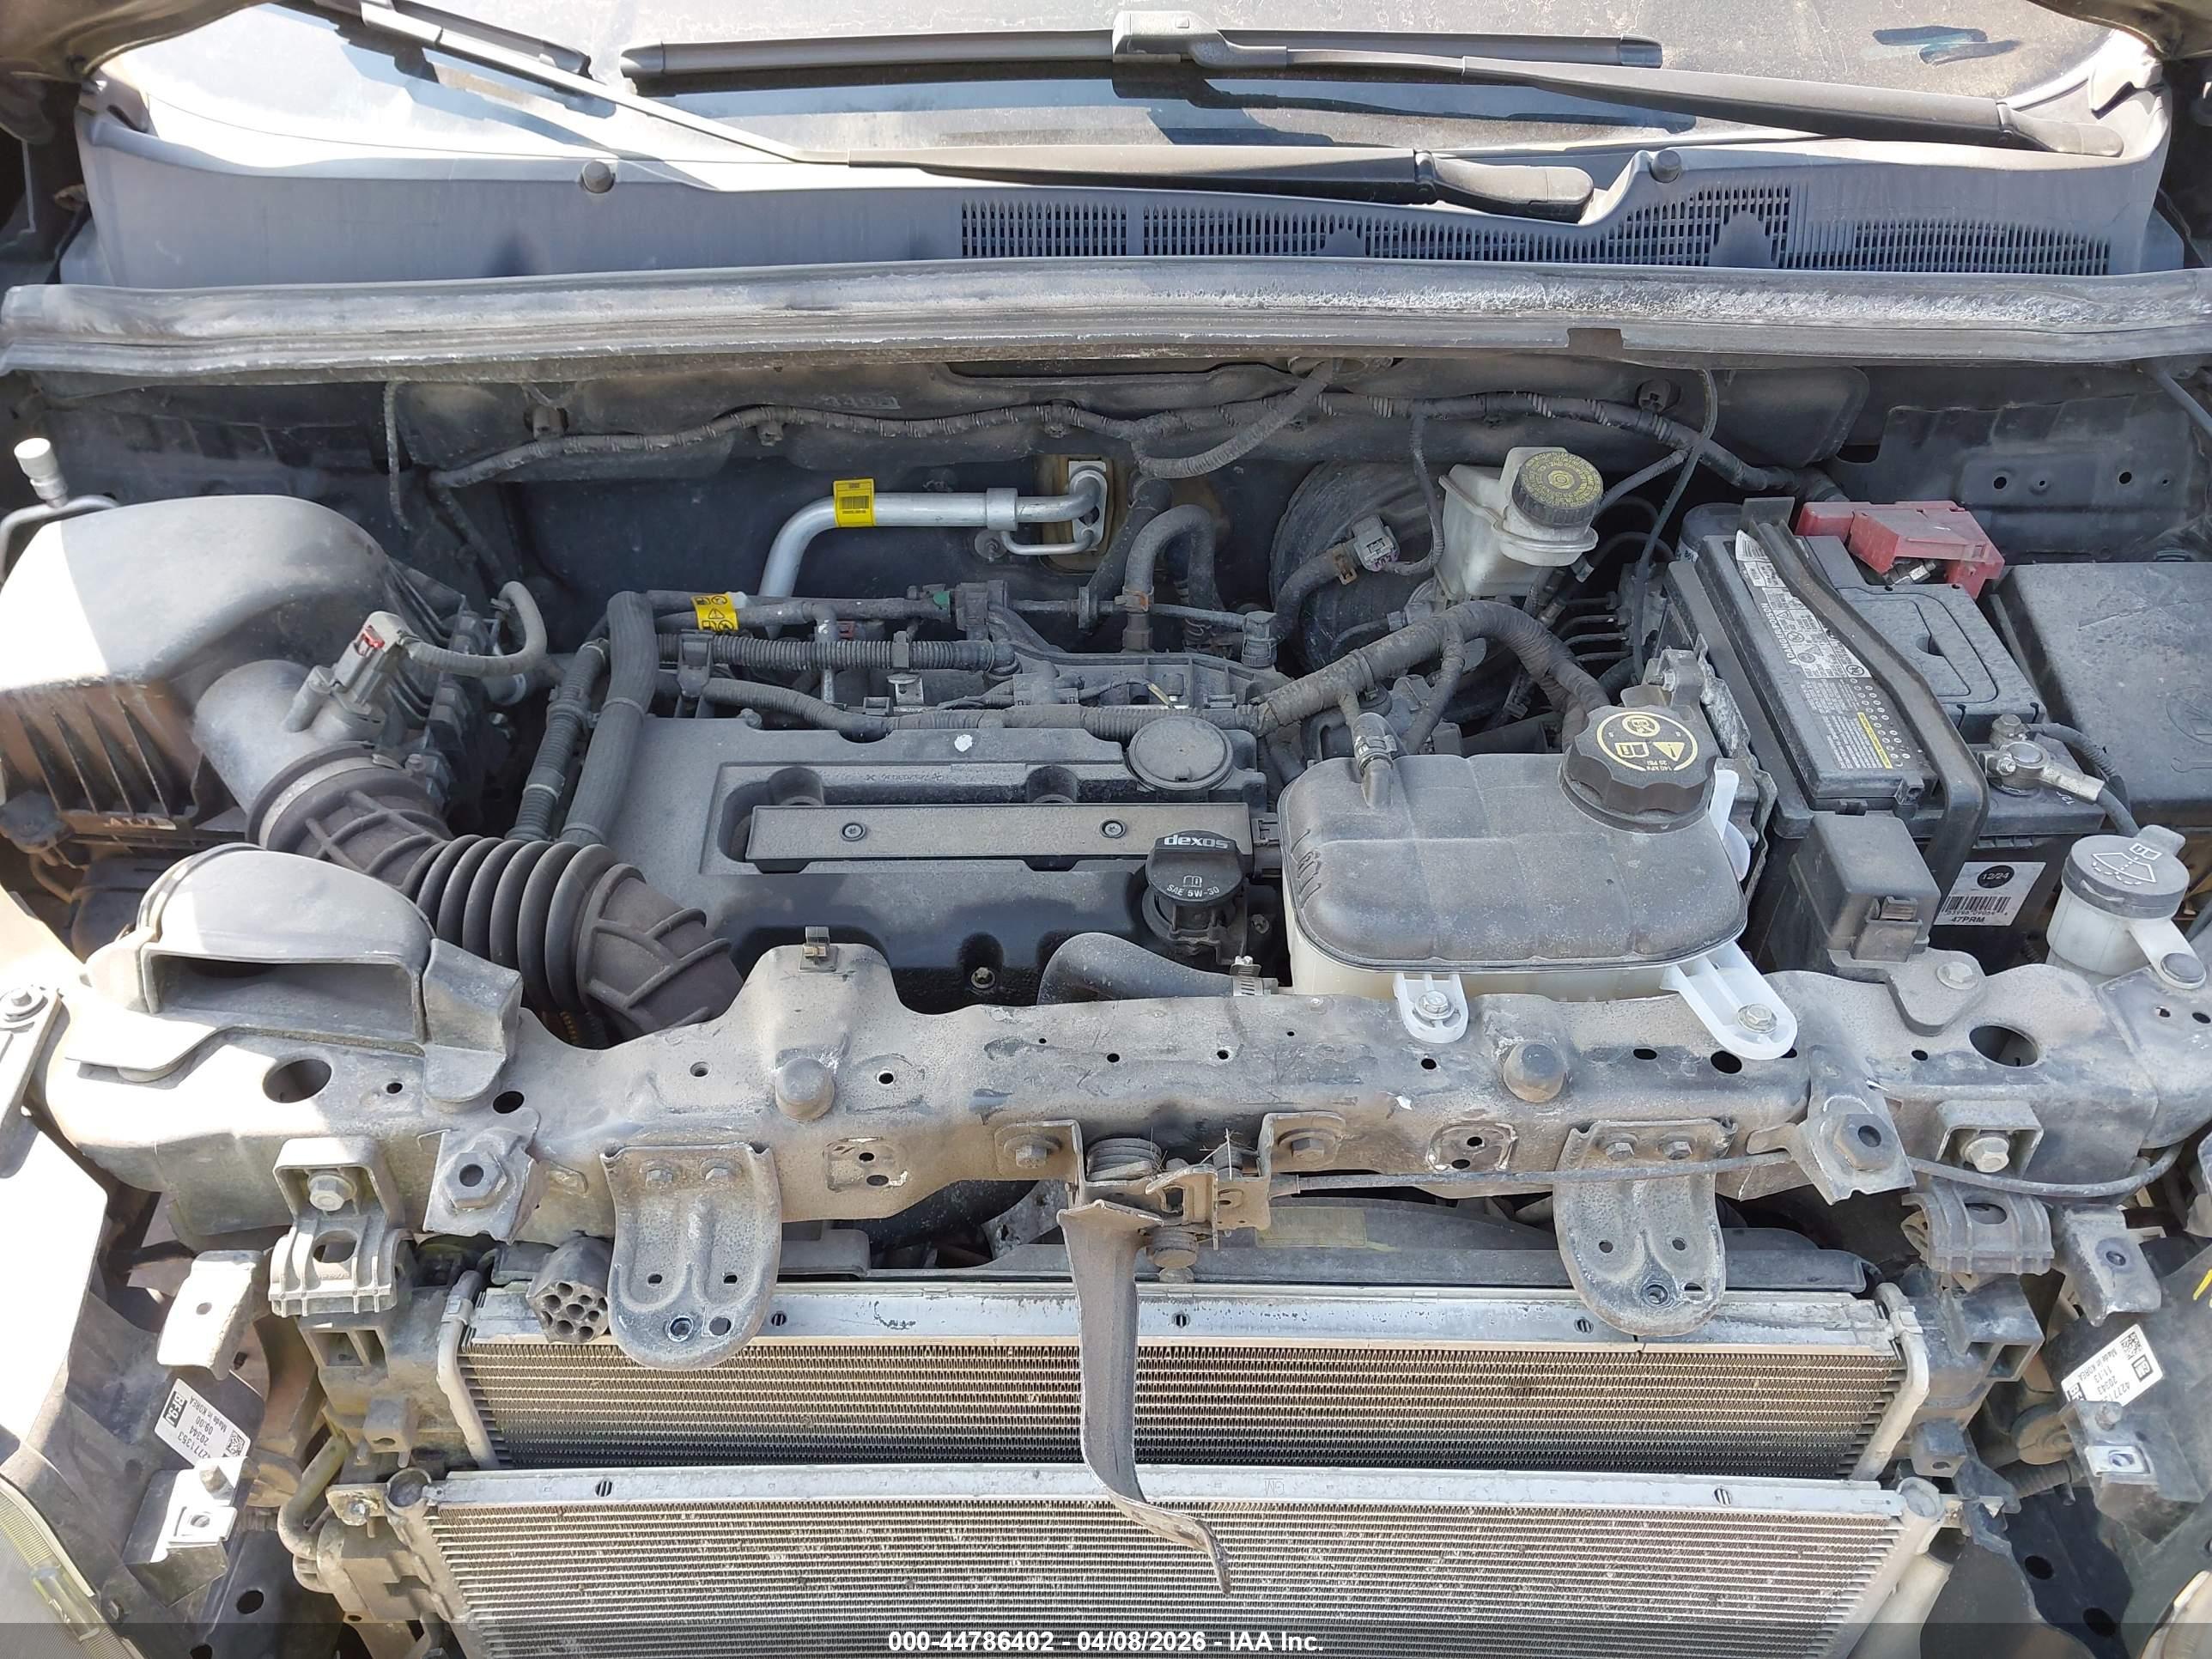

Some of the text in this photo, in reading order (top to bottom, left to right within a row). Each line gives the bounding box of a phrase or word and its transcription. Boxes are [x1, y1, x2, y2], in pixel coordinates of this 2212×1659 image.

[1760, 603, 1796, 659] DANGER/POISON
[1164, 834, 1231, 849] dexos
[1981, 872, 2010, 880] 12/24
[1166, 884, 1220, 898] SAE 5W-30
[2101, 1347, 2118, 1363] Made
[2077, 1364, 2096, 1382] KOREA
[164, 1392, 185, 1426] BF9J
[189, 1395, 208, 1416] KOREA
[195, 1415, 214, 1436] 09:00
[212, 1415, 228, 1433] Made
[189, 1425, 210, 1446] 20344
